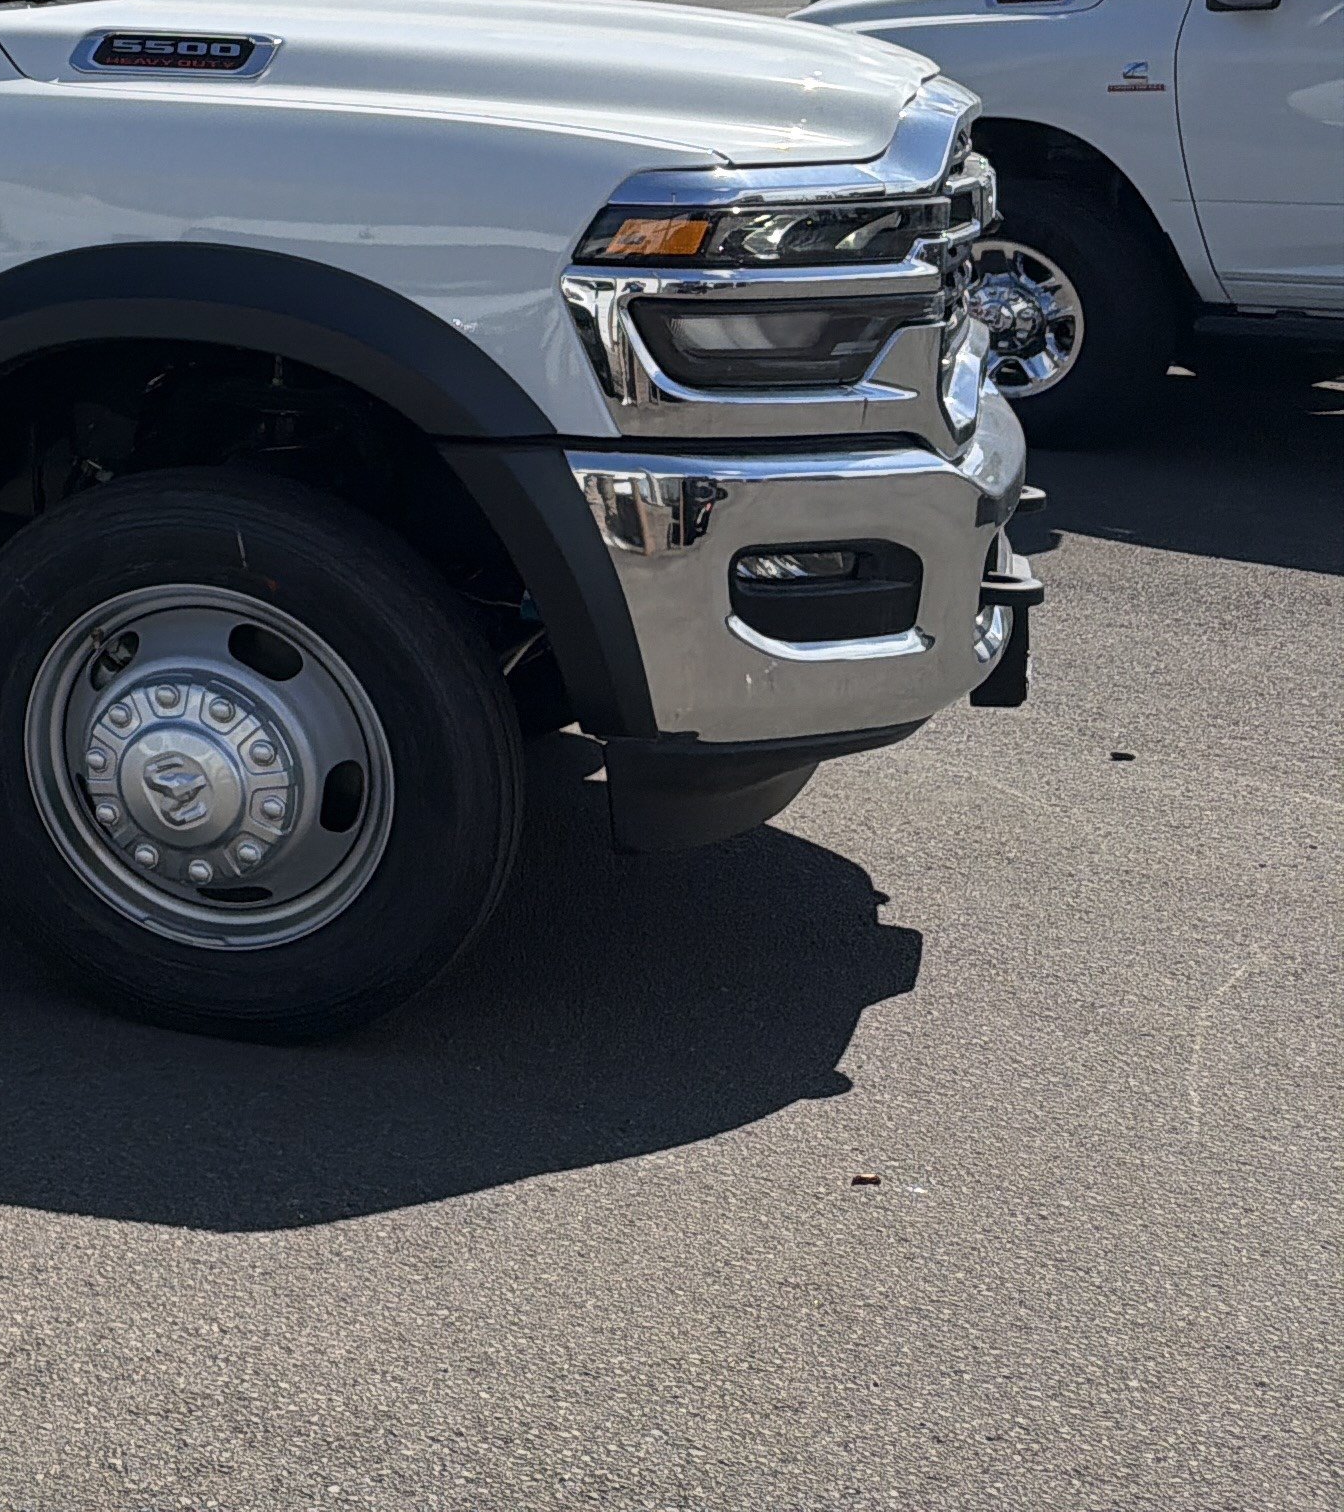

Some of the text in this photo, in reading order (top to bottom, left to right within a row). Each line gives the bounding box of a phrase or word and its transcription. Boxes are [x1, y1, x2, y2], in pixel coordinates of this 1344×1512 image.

[112, 39, 241, 57] 5500
[105, 56, 235, 69] HEAVY DUTY
